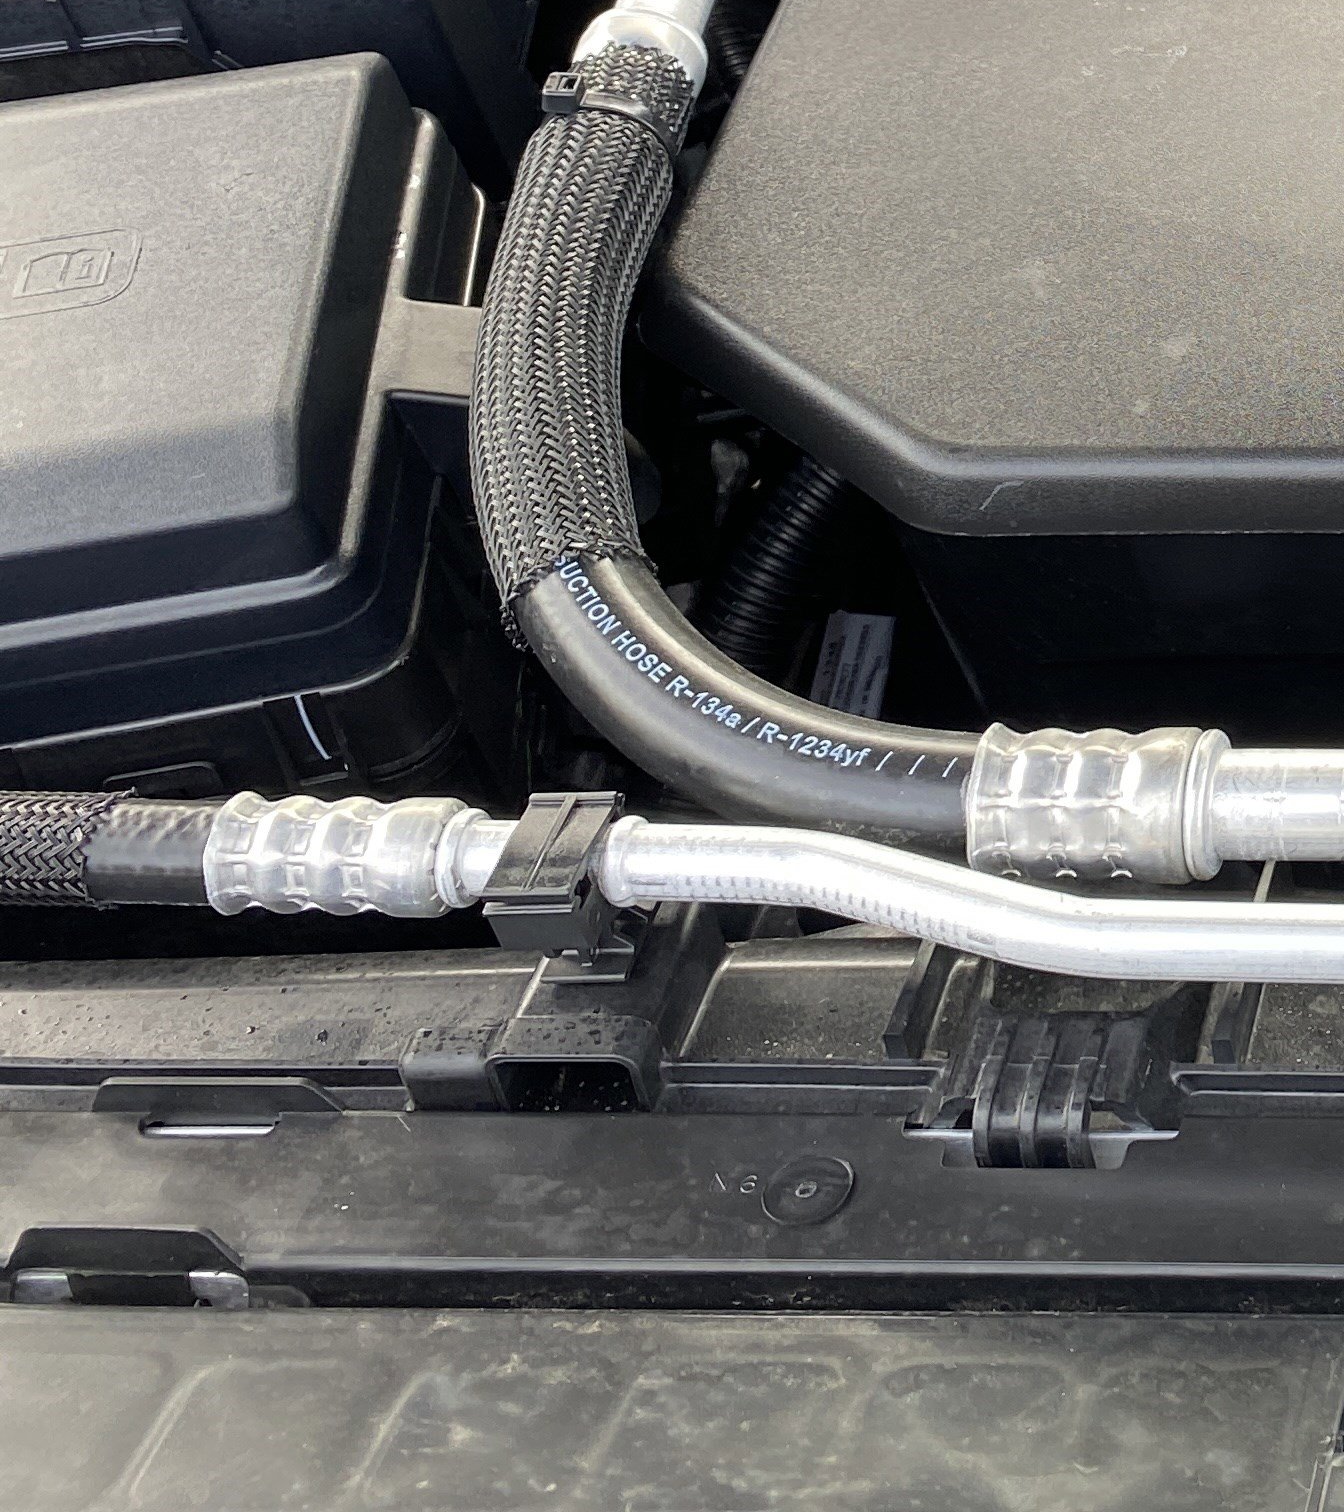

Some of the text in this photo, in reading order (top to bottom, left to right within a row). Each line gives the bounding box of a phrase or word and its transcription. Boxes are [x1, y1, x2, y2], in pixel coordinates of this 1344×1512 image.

[610, 629, 673, 684] HOSE
[664, 674, 741, 729] R-134a
[756, 721, 872, 768] R-1234yf
